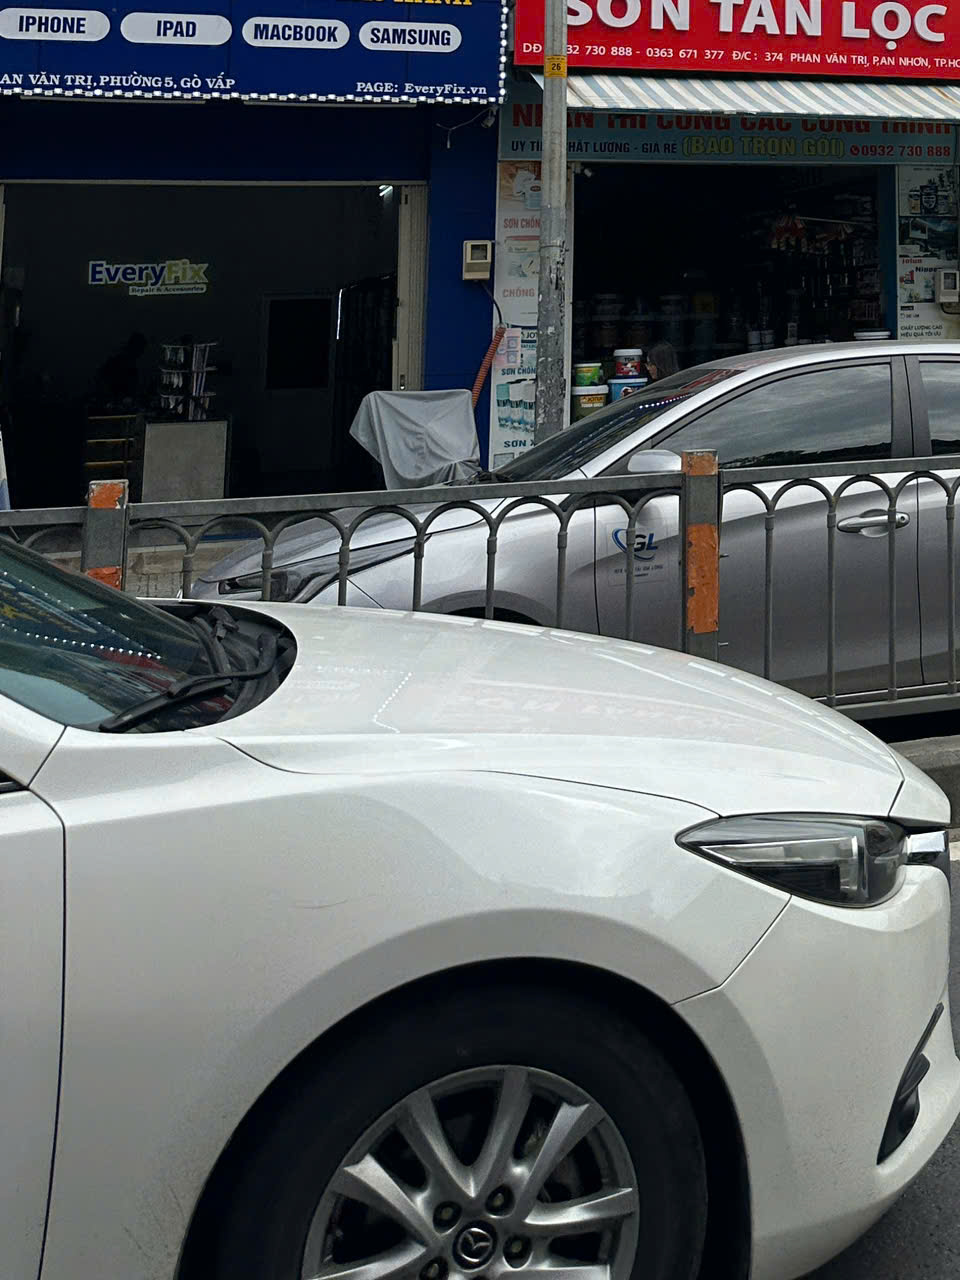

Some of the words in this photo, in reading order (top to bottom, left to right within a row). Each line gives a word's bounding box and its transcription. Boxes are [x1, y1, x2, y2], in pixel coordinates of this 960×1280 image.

[18, 15, 86, 34] IPHONE
[156, 20, 197, 38] IPAD
[253, 23, 338, 42] MACBOOK
[370, 27, 451, 46] SAMSUNG
[551, 62, 562, 71] 26
[585, 46, 606, 56] 730
[610, 46, 632, 56] 888
[646, 48, 673, 58] 0363
[679, 49, 698, 59] 671
[704, 50, 724, 60] 377
[765, 52, 783, 62] 374
[790, 53, 821, 64] PHAN
[825, 51, 847, 64] VĂN
[899, 56, 931, 69] NHƠN,
[29, 71, 60, 86] VĂN
[64, 74, 97, 90] TRỊ,
[180, 73, 201, 88] GÒ
[205, 72, 236, 89] VẤP
[356, 82, 398, 93] PAGE:
[404, 83, 487, 97] EveryFix.vn
[682, 136, 733, 158] (BAO
[741, 136, 796, 158] TRỌN
[861, 145, 894, 157] 0932
[900, 145, 922, 157] 730
[927, 146, 951, 157] 888
[89, 261, 207, 286] EveryFix
[503, 439, 527, 448] SƠN
